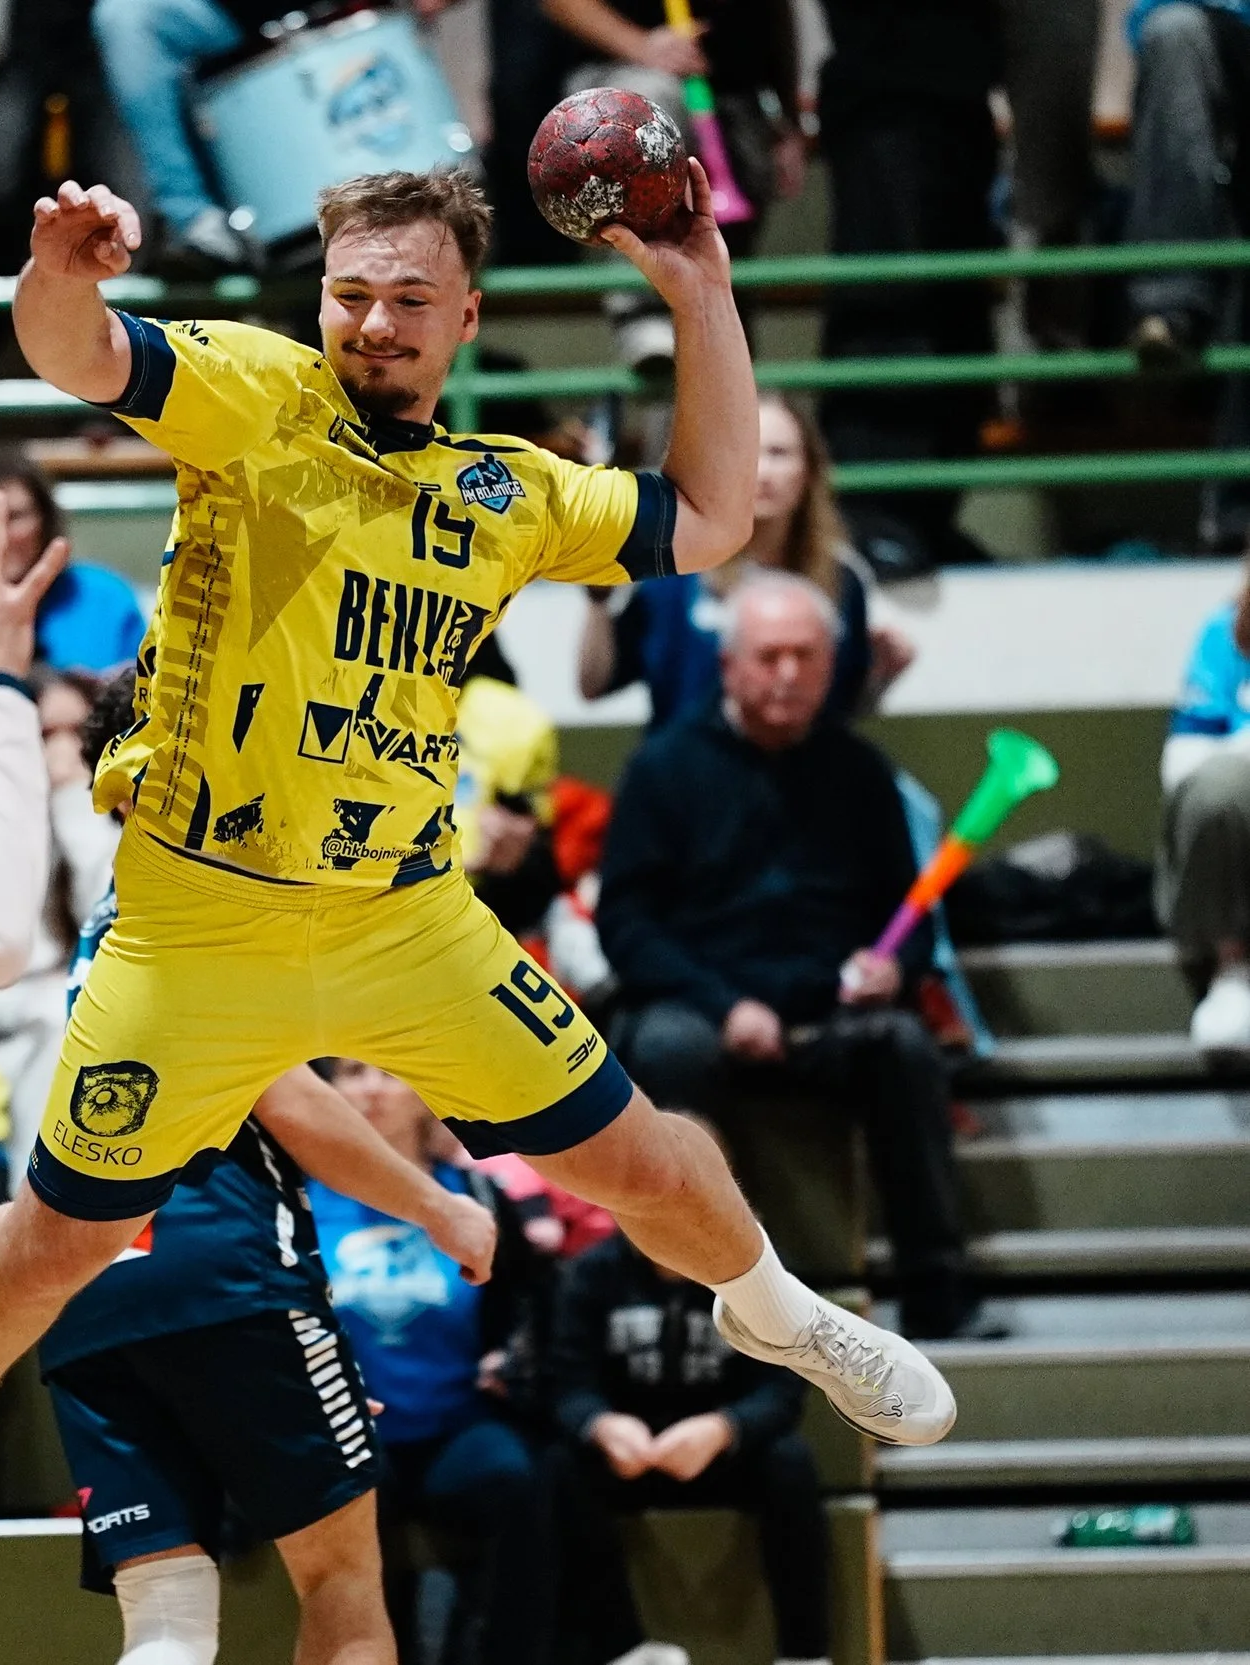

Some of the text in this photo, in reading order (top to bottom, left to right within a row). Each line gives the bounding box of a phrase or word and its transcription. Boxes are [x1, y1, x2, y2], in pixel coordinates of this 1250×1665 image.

[476, 481, 524, 501] BOJNICE
[411, 490, 475, 570] 19
[488, 960, 575, 1047] 19
[52, 1119, 143, 1166] ELESKO
